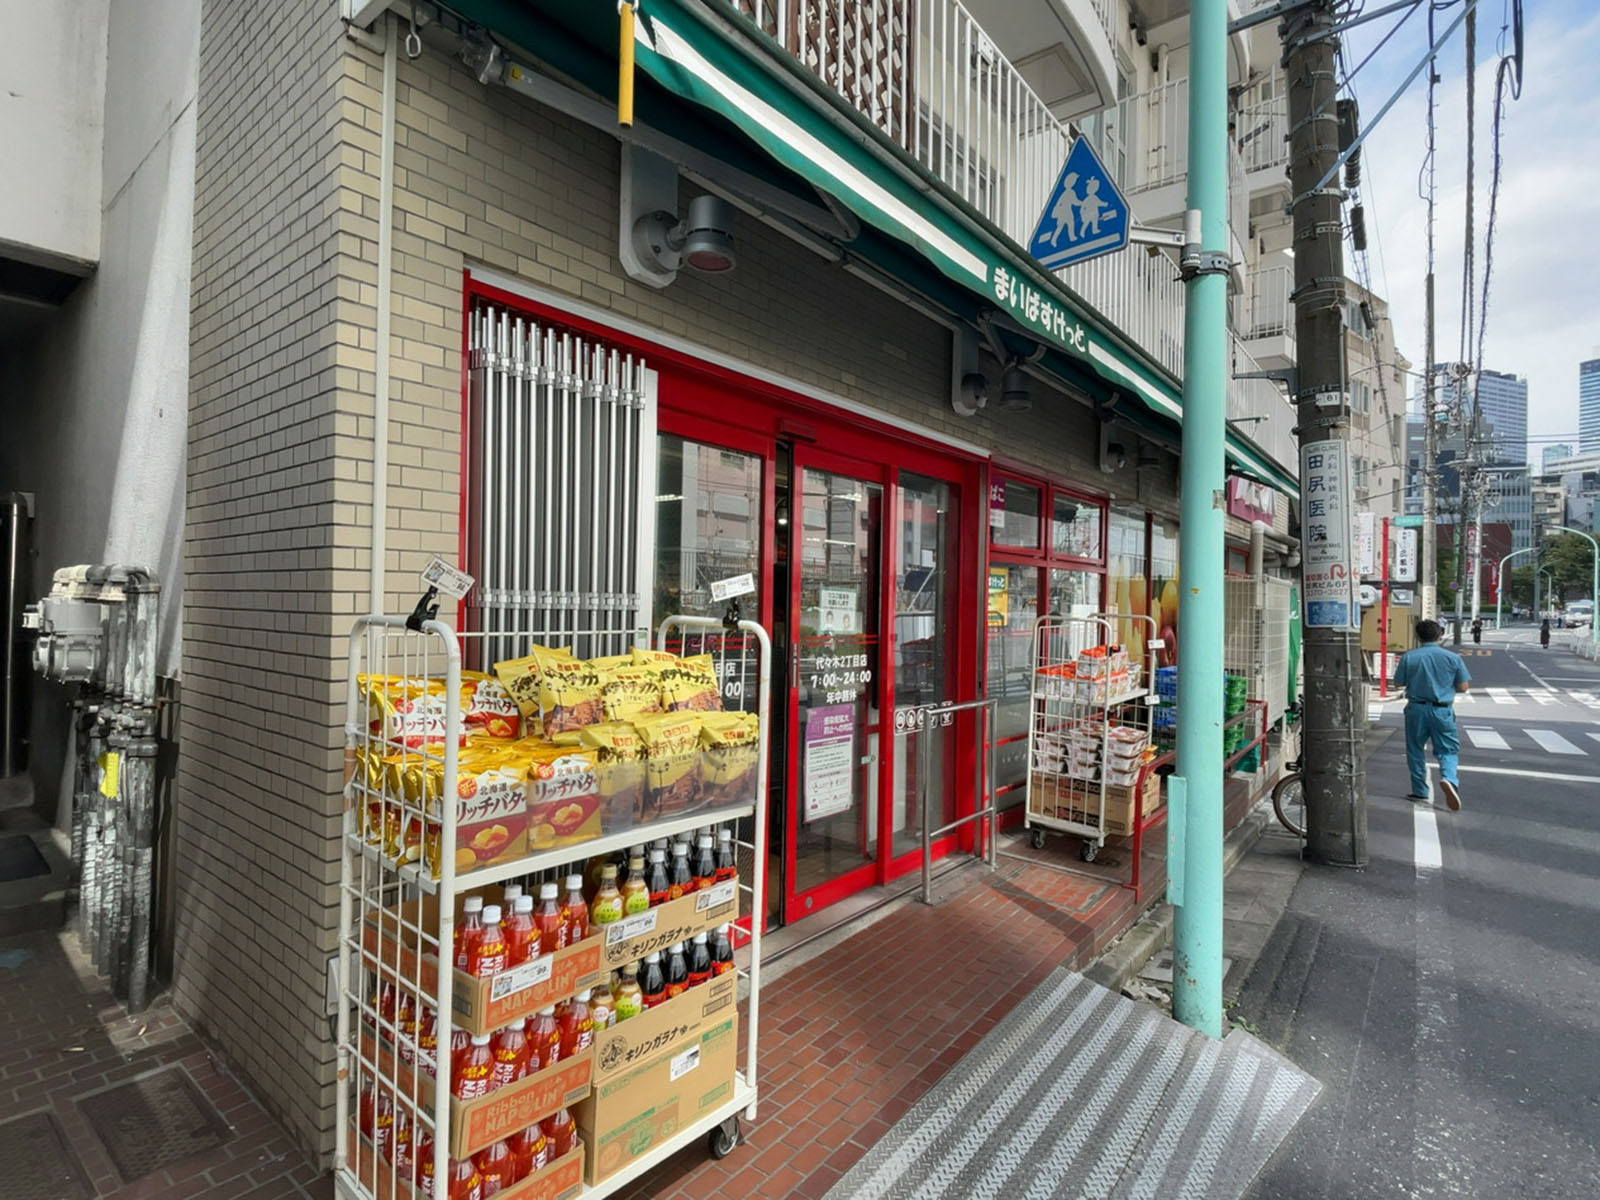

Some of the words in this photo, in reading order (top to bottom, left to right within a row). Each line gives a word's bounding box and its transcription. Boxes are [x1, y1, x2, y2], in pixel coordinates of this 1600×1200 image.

[993, 266, 1086, 353] まいばすけっと
[1307, 454, 1327, 542] 田尻医院
[816, 654, 868, 670] 代々木2丁目店
[826, 690, 857, 704] 年中無休
[480, 782, 507, 796] 北海道
[629, 925, 687, 957] キリンガラナ
[624, 1025, 679, 1063] キリンガラナ
[487, 1091, 535, 1118] Ribbon
